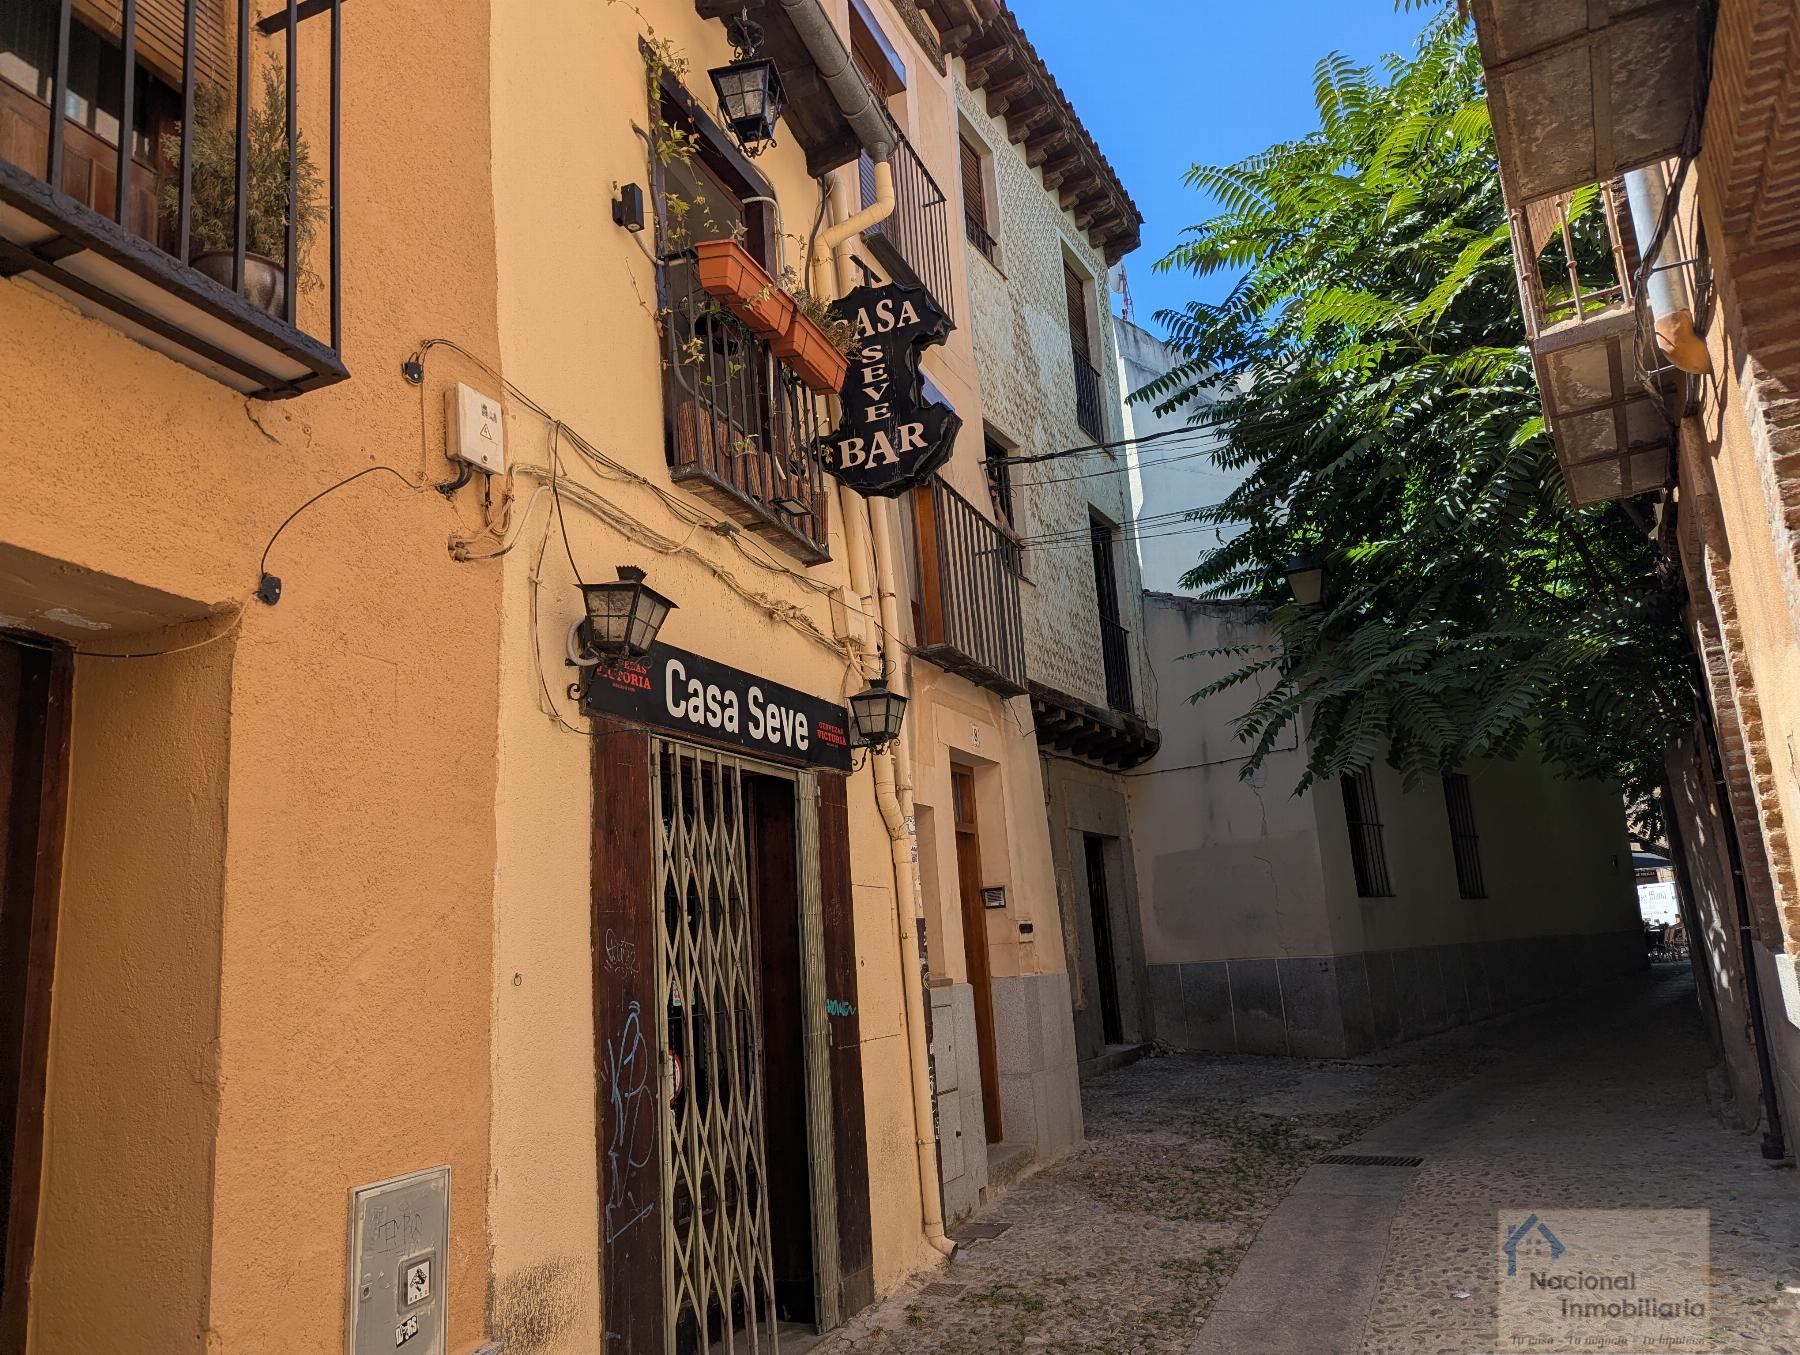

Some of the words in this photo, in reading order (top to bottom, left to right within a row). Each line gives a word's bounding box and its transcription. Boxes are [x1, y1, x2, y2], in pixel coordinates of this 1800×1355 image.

[861, 345, 891, 423] SEVE
[838, 421, 928, 470] BAR
[665, 658, 739, 734] Casa
[748, 685, 809, 751] Seve
[816, 729, 847, 746] VICTORIA
